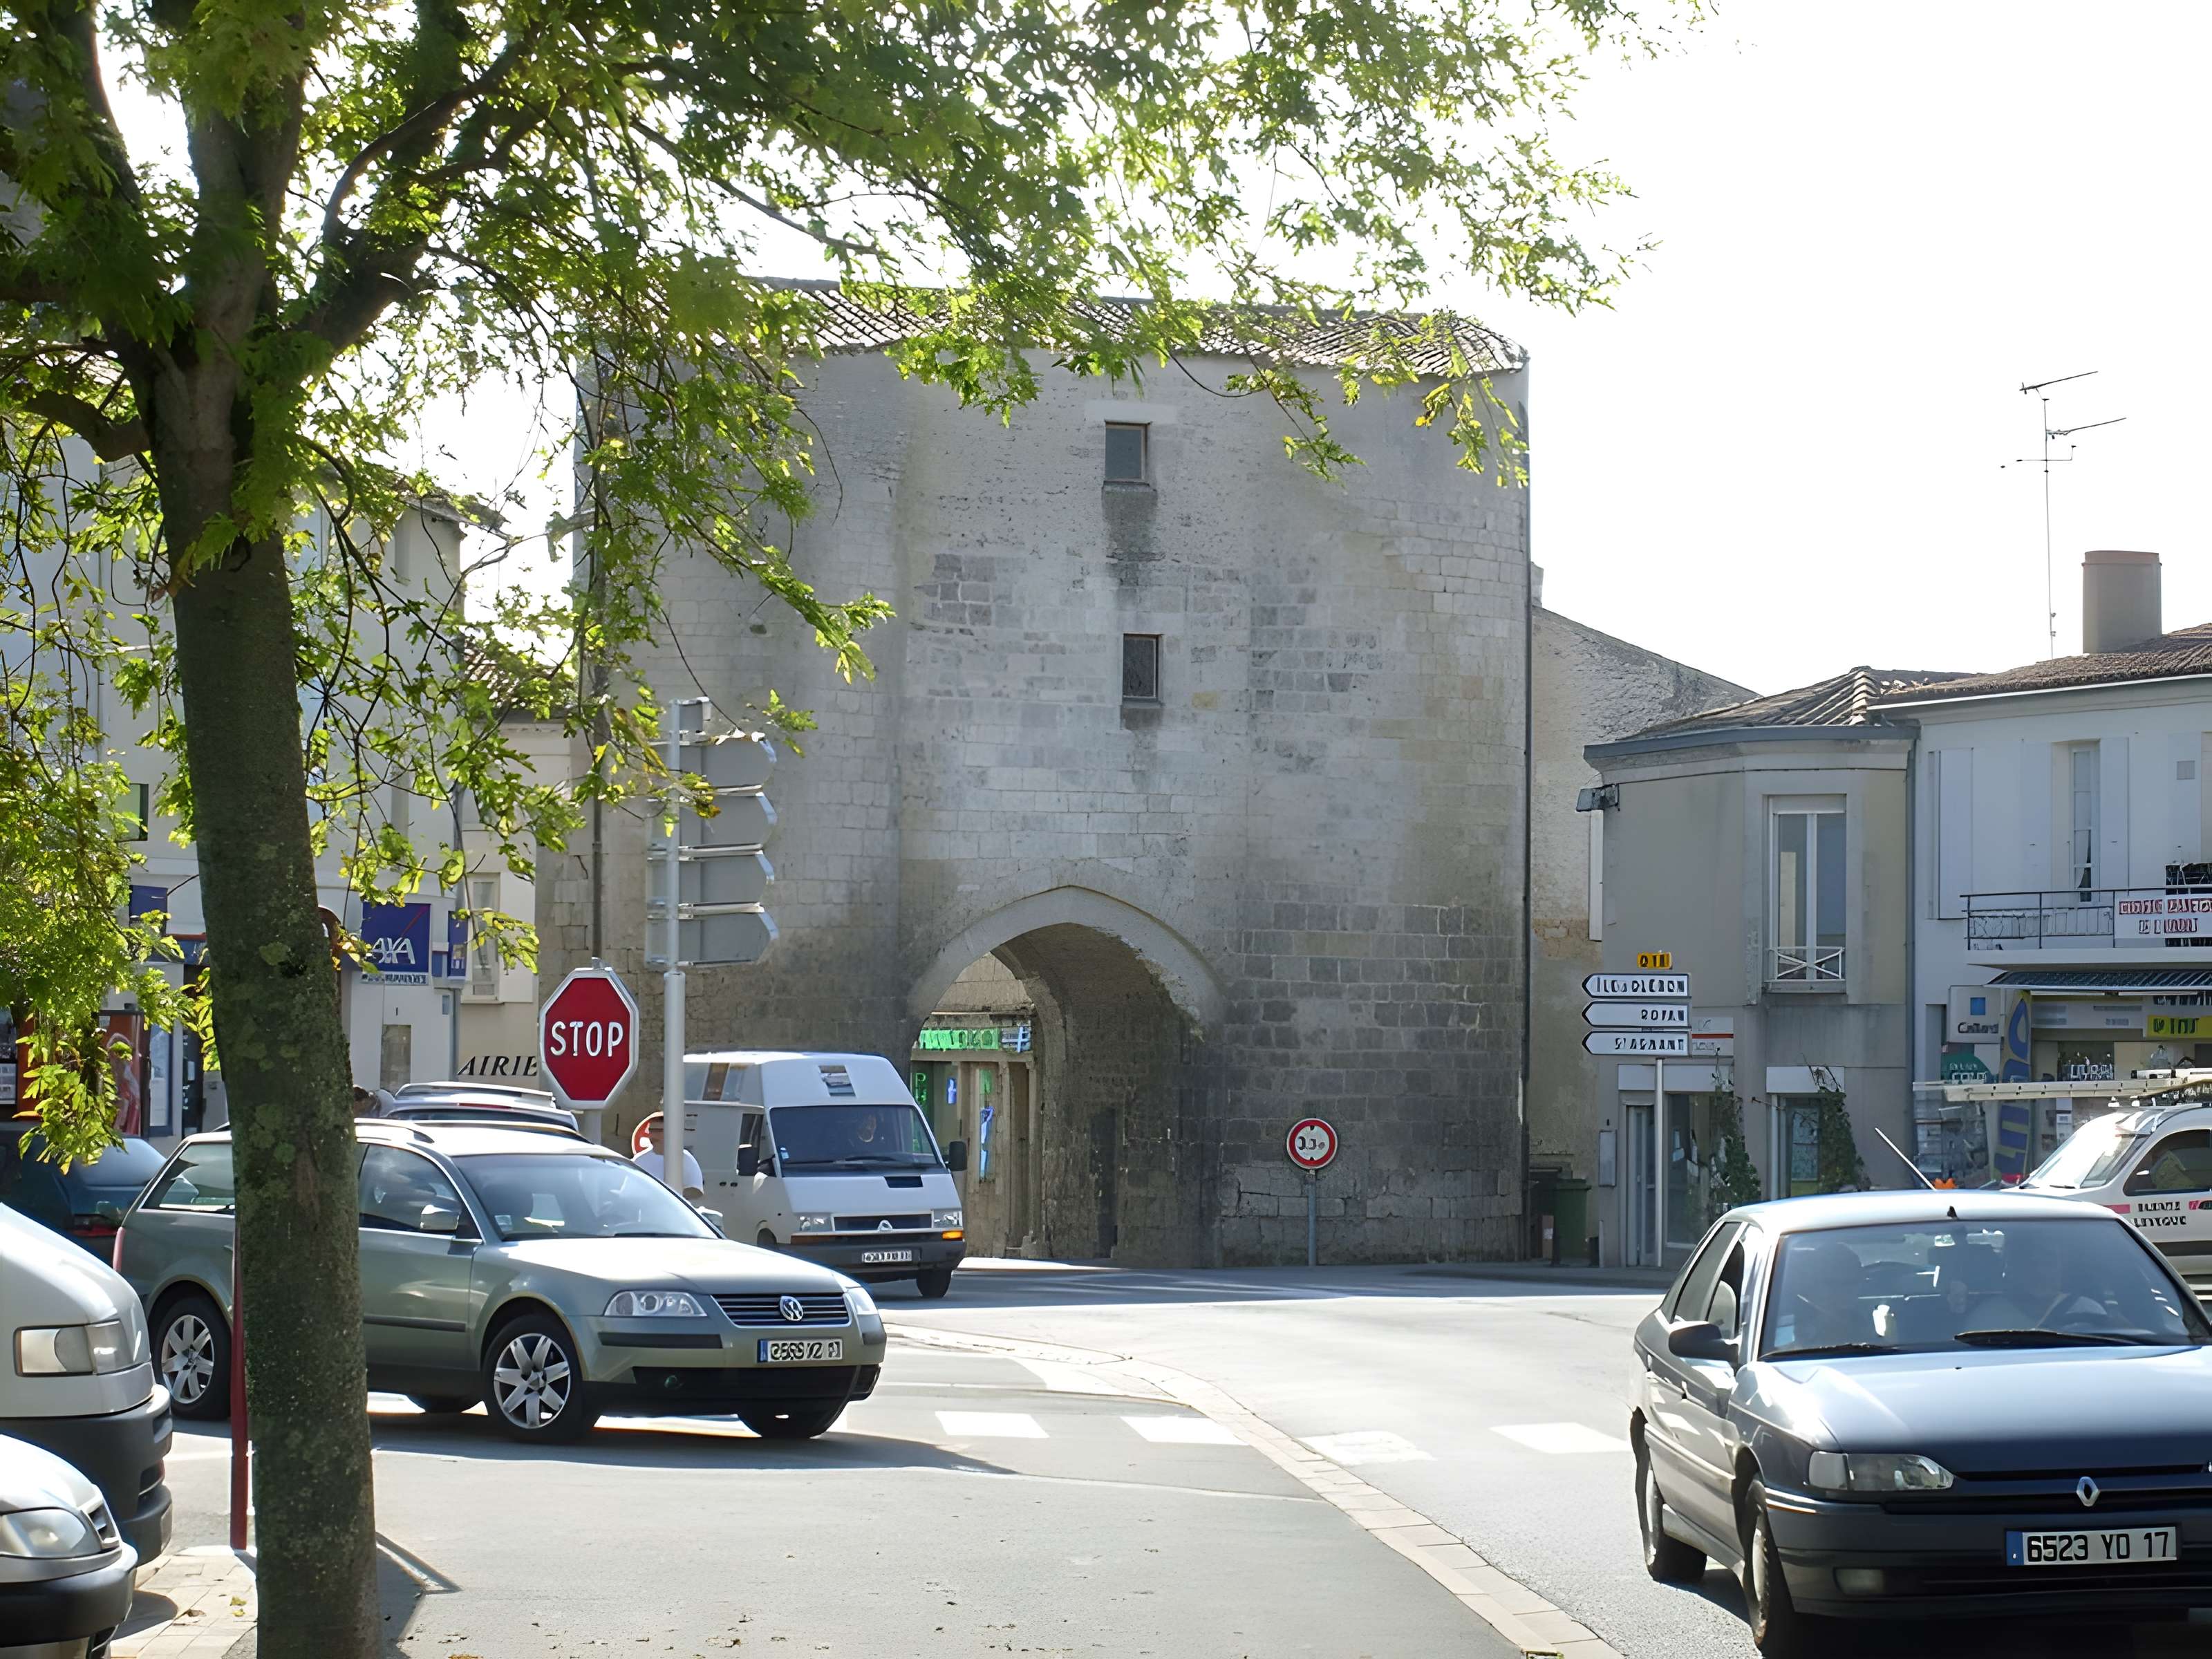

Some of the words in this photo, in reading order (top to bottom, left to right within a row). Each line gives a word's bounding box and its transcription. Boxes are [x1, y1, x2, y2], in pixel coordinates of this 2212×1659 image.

[550, 1021, 624, 1057] STOP
[2027, 1535, 2088, 1562] 6523
[2144, 1531, 2169, 1557] 17
